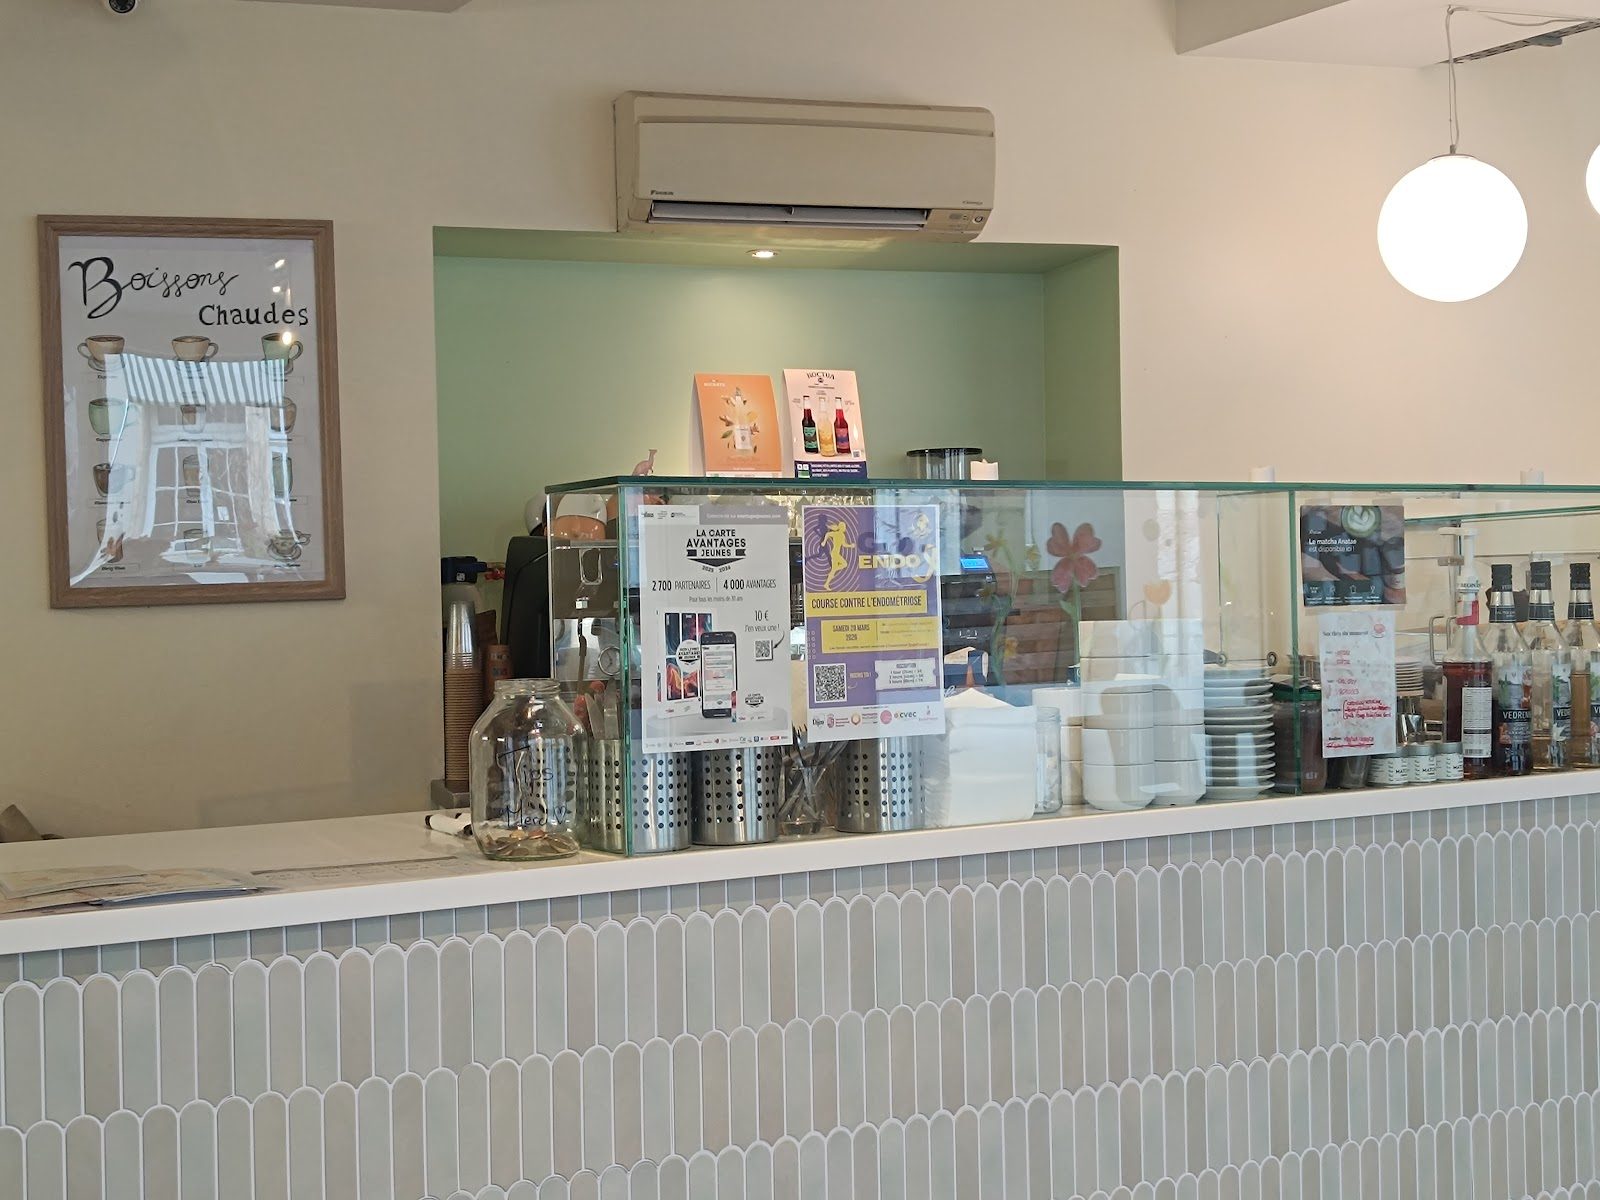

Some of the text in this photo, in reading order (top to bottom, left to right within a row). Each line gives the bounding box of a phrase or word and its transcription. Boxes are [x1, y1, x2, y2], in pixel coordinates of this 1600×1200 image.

[68, 256, 239, 319] Boissons
[199, 302, 309, 326] Chaudes
[696, 529, 736, 537] LA CARTE
[686, 538, 747, 548] AVANTAGES
[701, 549, 732, 557] JEUNES
[858, 554, 921, 569] ENDO
[674, 580, 711, 591] PARTENAIRES
[746, 578, 777, 589] AVANTAGES
[811, 598, 839, 609] COURSE
[839, 597, 866, 608] CONTRE
[755, 610, 763, 621] 10
